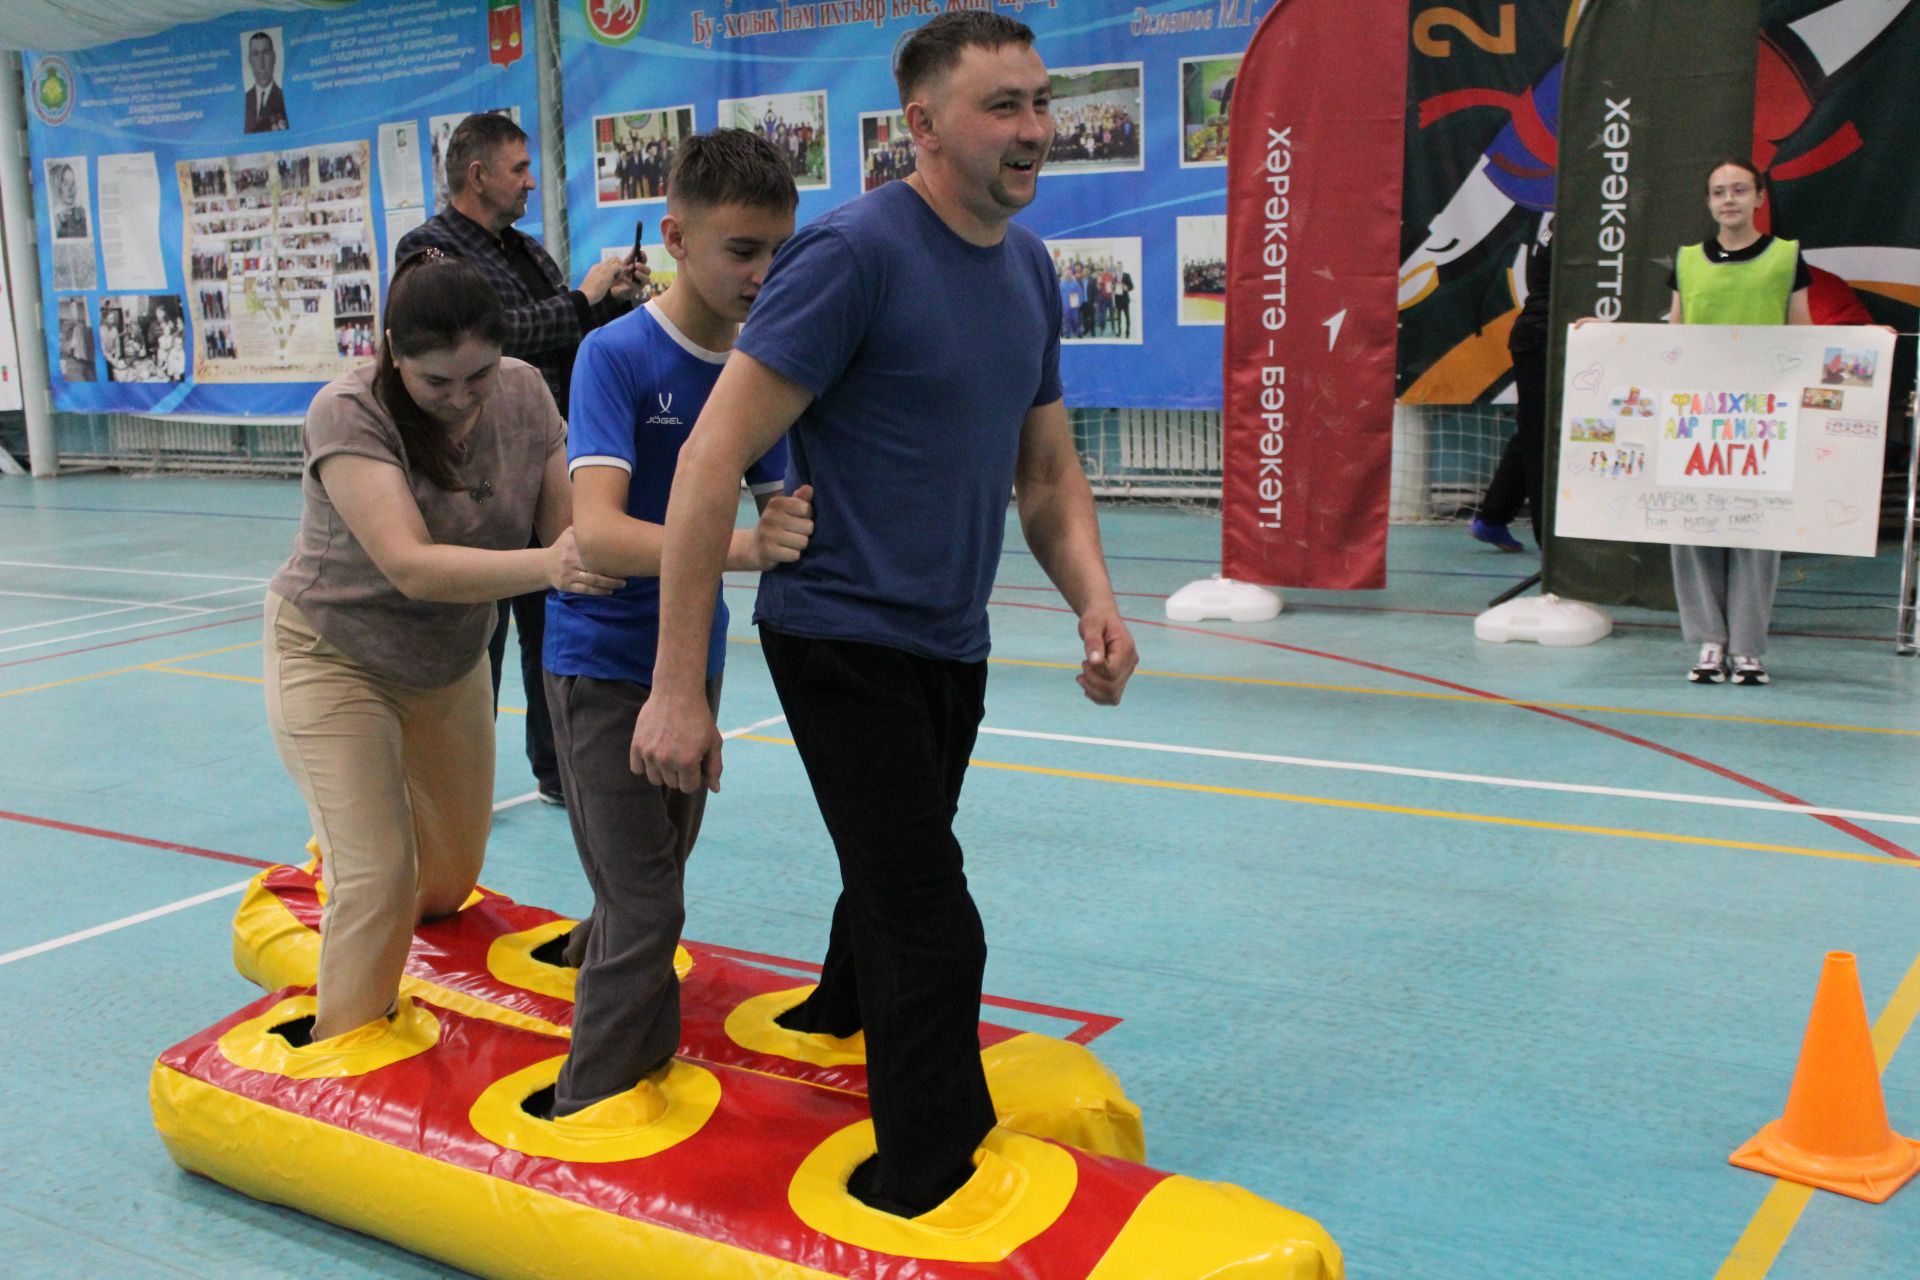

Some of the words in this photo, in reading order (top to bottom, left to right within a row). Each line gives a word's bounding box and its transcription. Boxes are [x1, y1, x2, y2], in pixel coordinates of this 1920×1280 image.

[691, 10, 714, 48] Бу
[1261, 126, 1291, 331] ХӘРӘКӘТТӘ
[1595, 98, 1631, 322] ХӘРӘКӘТТӘ
[645, 415, 683, 425] JÖGEL
[1259, 365, 1286, 530] БӘРӘКӘТ!
[1684, 439, 1769, 476] АЛГА!
